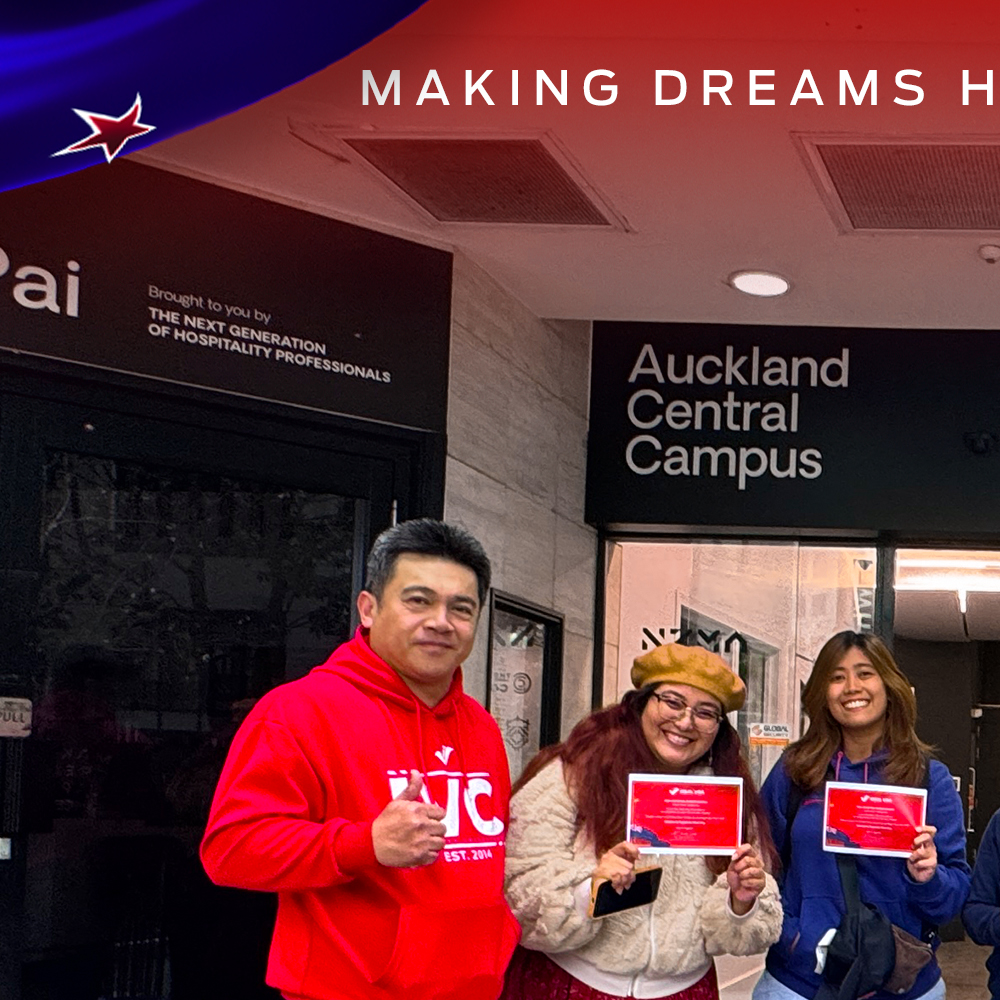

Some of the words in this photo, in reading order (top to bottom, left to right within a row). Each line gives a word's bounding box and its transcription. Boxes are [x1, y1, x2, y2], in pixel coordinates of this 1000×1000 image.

[148, 285, 204, 309] Brought
[207, 298, 222, 312] to
[225, 304, 250, 317] you
[254, 309, 271, 325] by
[148, 306, 180, 324] THE
[184, 314, 226, 334] NEXT
[229, 324, 326, 355] GENERATION
[148, 323, 171, 337] OF
[174, 328, 272, 359] HOSPITALITY
[275, 349, 392, 383] PROFESSIONALS
[628, 343, 849, 387] Auckland
[627, 389, 799, 432] Central
[625, 434, 823, 490] Campus
[444, 850, 470, 862] EST.
[471, 849, 493, 861] 2014
